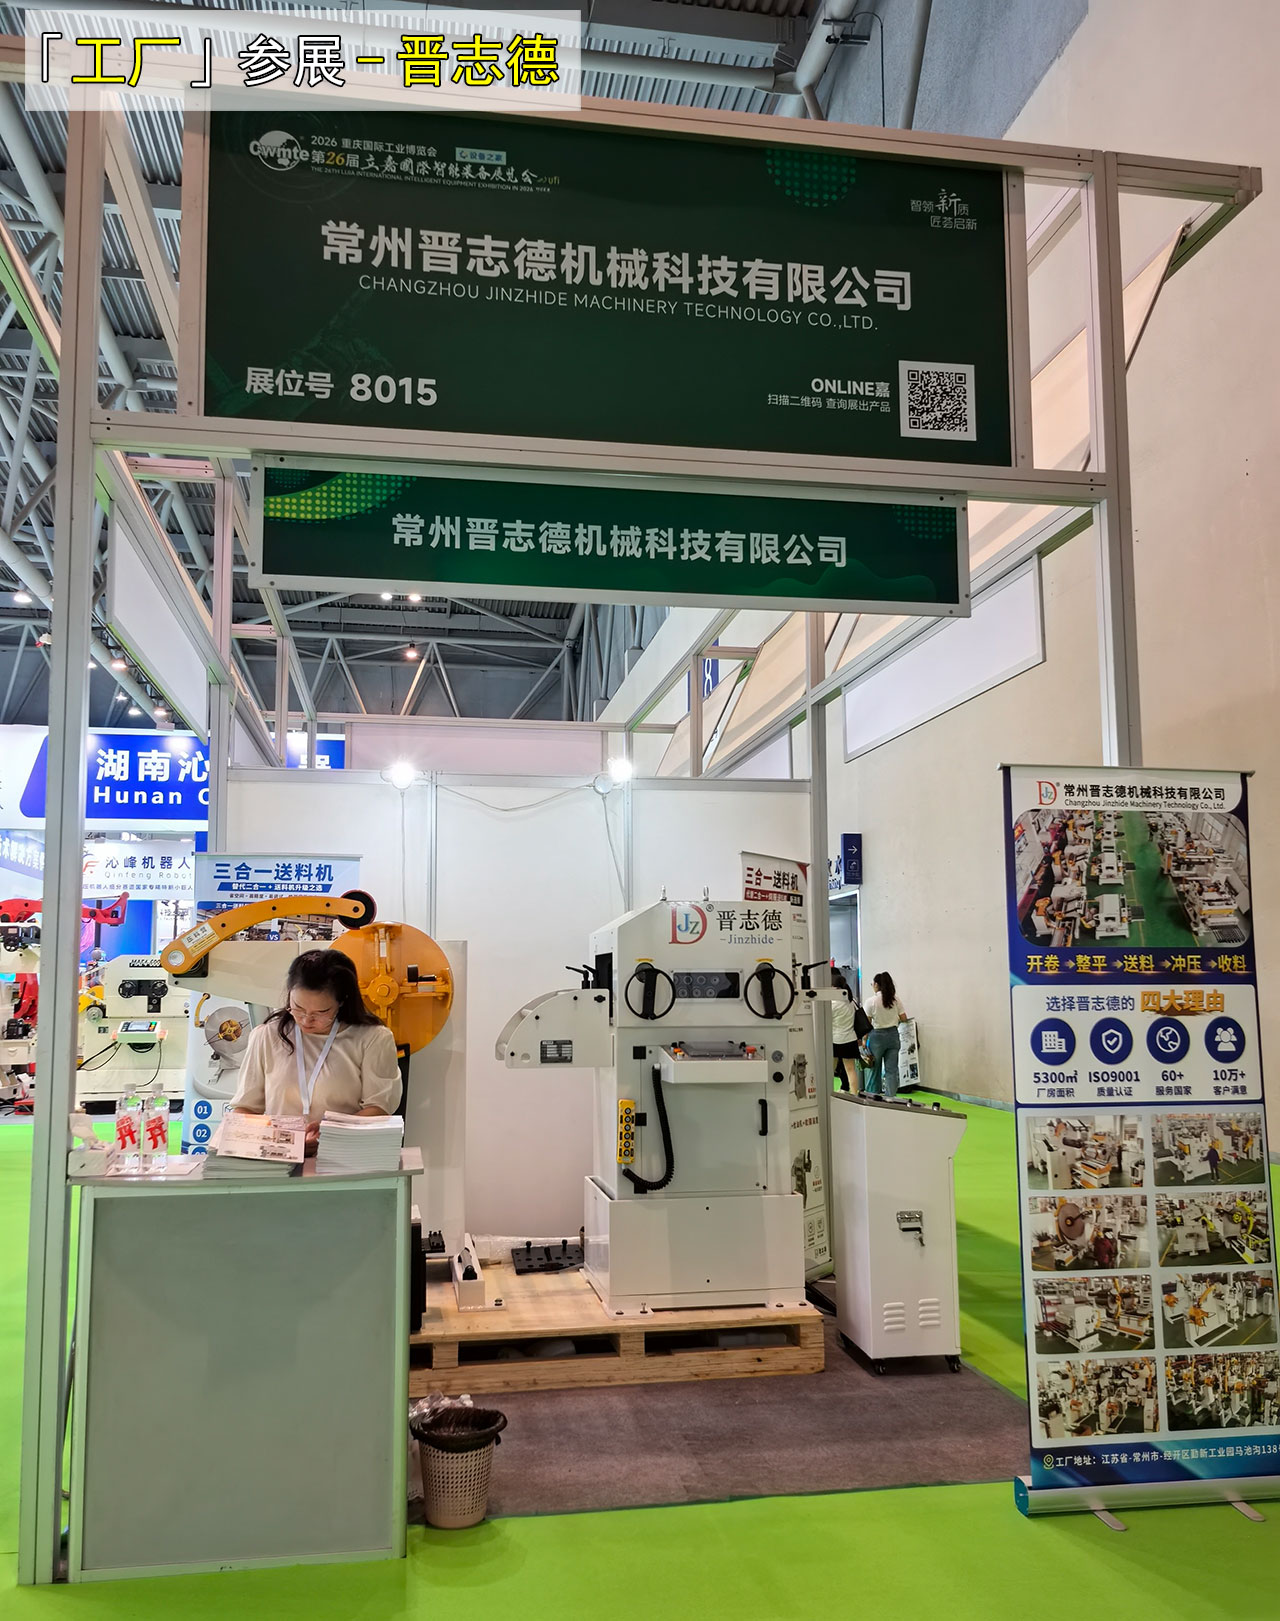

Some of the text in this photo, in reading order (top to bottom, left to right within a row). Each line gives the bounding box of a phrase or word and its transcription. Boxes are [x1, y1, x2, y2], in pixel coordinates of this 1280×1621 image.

[311, 135, 437, 157] 2026 重庆国际工业博览会
[321, 219, 912, 311] 常州晋志德机械科技有限公司
[358, 274, 479, 299] CHANGZHOU
[485, 286, 568, 307] JINZHIDE
[574, 293, 678, 316] MACHINERY
[684, 302, 802, 325] TECHNOLOGY
[245, 366, 438, 406] 展位号 8015
[767, 393, 891, 413] 扫描二维码 查询展出产品
[391, 512, 848, 569] 常州晋志德机械科技有限公司
[93, 785, 183, 805] Hunan
[1063, 783, 1226, 801] 常州晋志德机械科技有限公司
[1064, 799, 1101, 808] Changzhou
[1102, 799, 1129, 808] Jinzhide
[1130, 800, 1163, 810] Machinery
[1163, 801, 1199, 811] Technology
[105, 855, 190, 869] 沁峰机器人
[213, 862, 334, 882] 三合一送料机
[745, 867, 799, 891] 三合一送料机
[716, 909, 783, 931] 晋志德
[1026, 955, 1246, 973] 开卷 整平 送料 冲压 收料
[1045, 989, 1225, 1013] 选择晋志德的 四大理由
[1088, 1070, 1140, 1083] ISO9001
[1161, 1069, 1184, 1081] 60+
[1213, 1068, 1246, 1081] 10万+
[1036, 1087, 1075, 1098] 厂房面积
[1097, 1086, 1133, 1097] 质量认证
[1155, 1085, 1192, 1096] 服务国家
[1213, 1085, 1247, 1096] 客户满意
[196, 1106, 208, 1114] 01
[196, 1129, 207, 1138] 02
